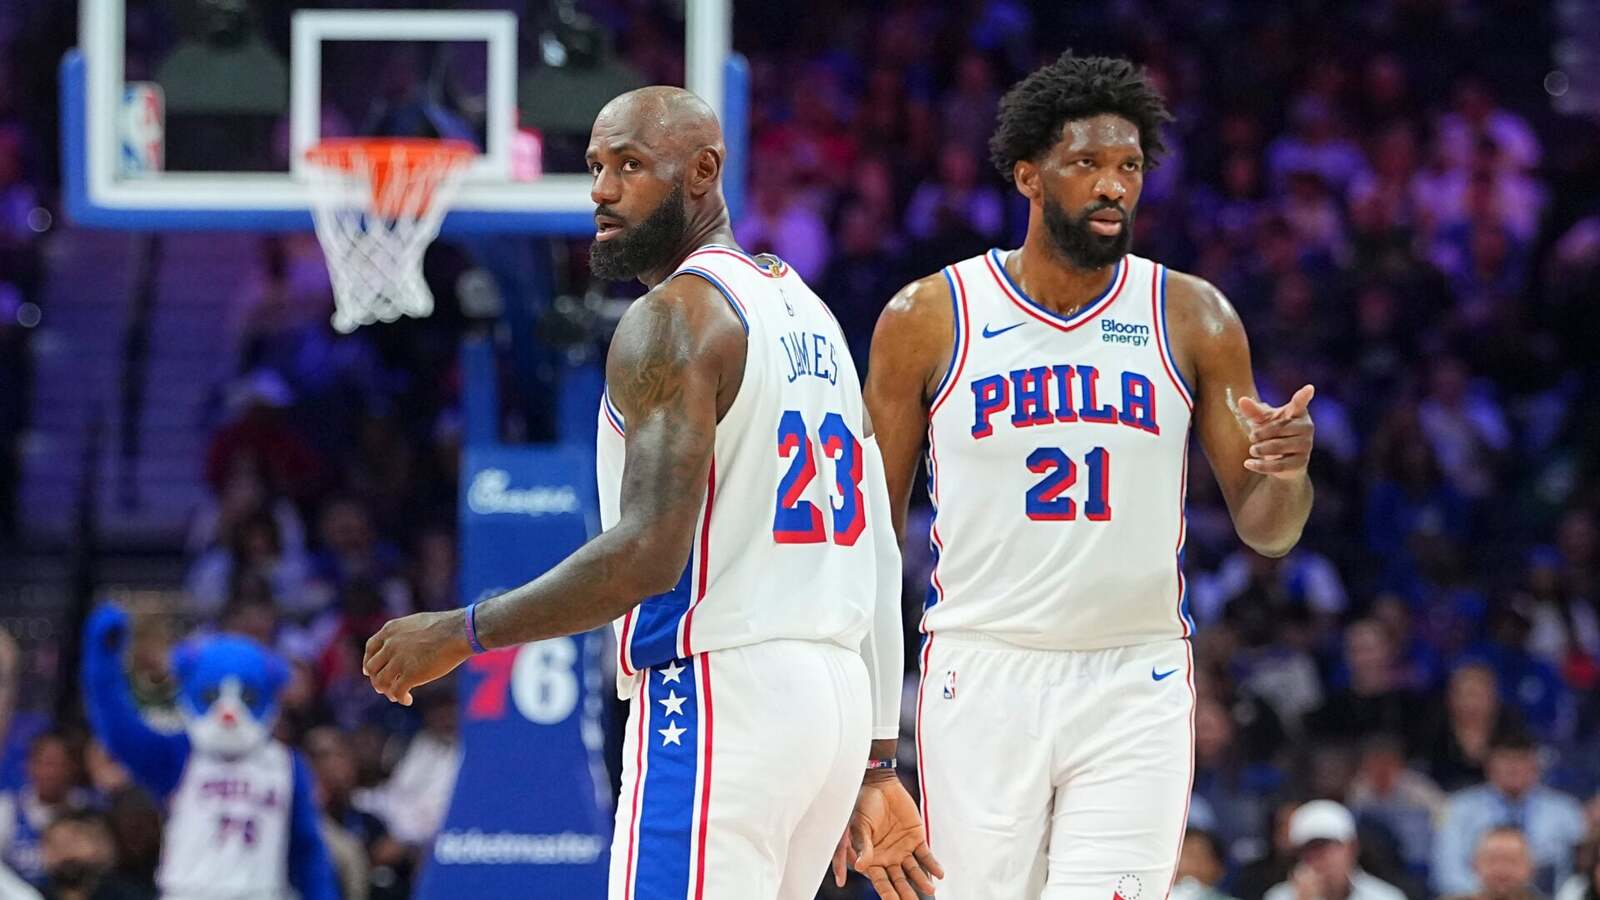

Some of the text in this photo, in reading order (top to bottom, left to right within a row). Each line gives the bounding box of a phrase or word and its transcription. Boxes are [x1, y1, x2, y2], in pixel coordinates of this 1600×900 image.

[780, 331, 837, 386] JAMES
[1101, 319, 1149, 335] Bloom
[1102, 333, 1149, 346] energy
[971, 364, 1160, 440] PHILA
[773, 410, 866, 547] 23
[1026, 446, 1112, 521] 21
[467, 635, 580, 725] 76
